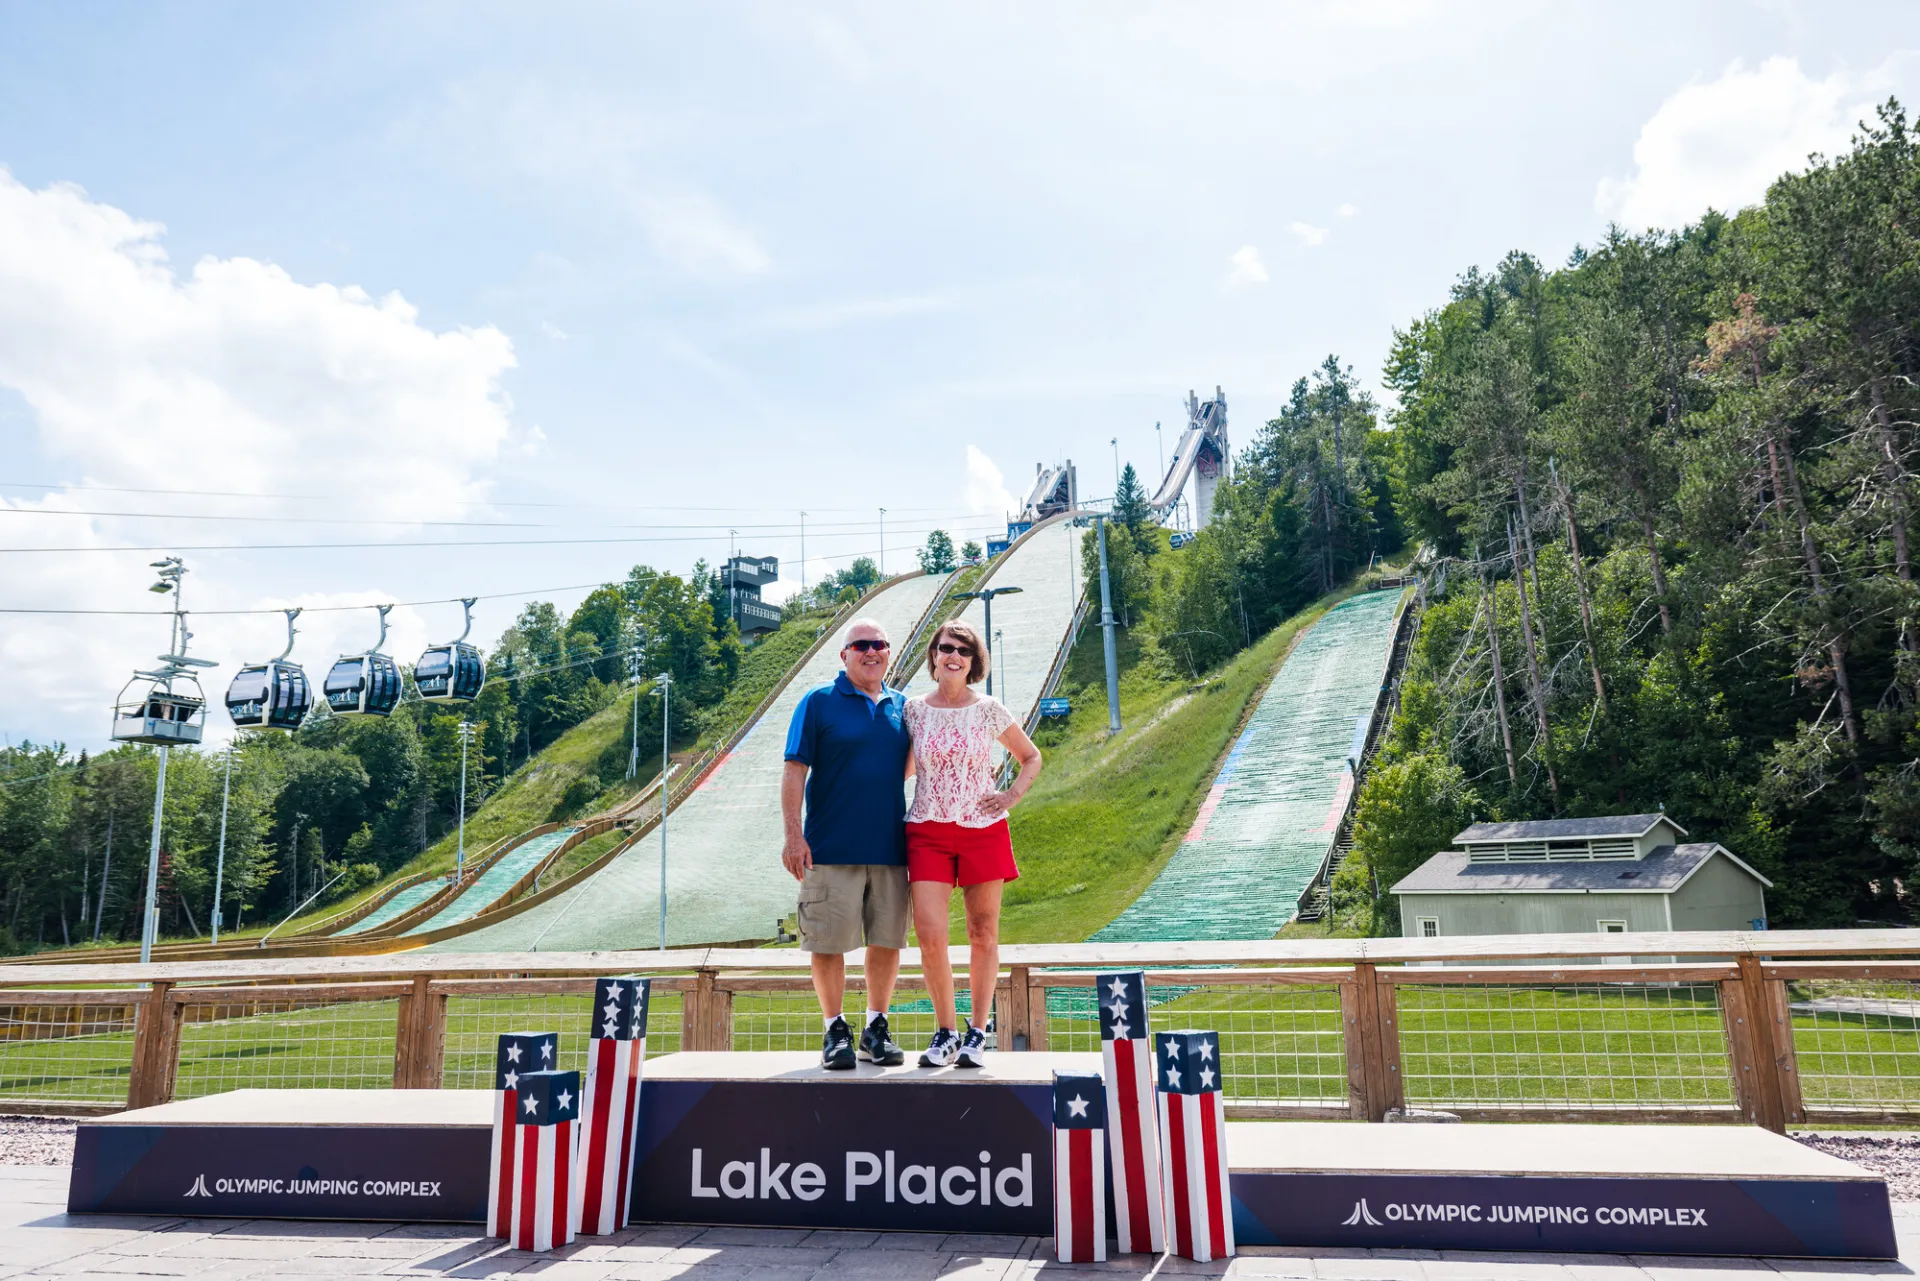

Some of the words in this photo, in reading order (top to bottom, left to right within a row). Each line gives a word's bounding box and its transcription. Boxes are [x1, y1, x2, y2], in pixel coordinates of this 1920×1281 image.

[215, 1178, 284, 1194] OLYMPIC
[285, 1179, 359, 1195] JUMPING
[362, 1180, 441, 1197] COMPLEX
[691, 1147, 827, 1201] Lake
[845, 1150, 1033, 1207] Placid
[1384, 1203, 1482, 1223] OLYMPIC
[1486, 1205, 1589, 1225] JUMPING
[1595, 1206, 1708, 1227] COMPLEX
